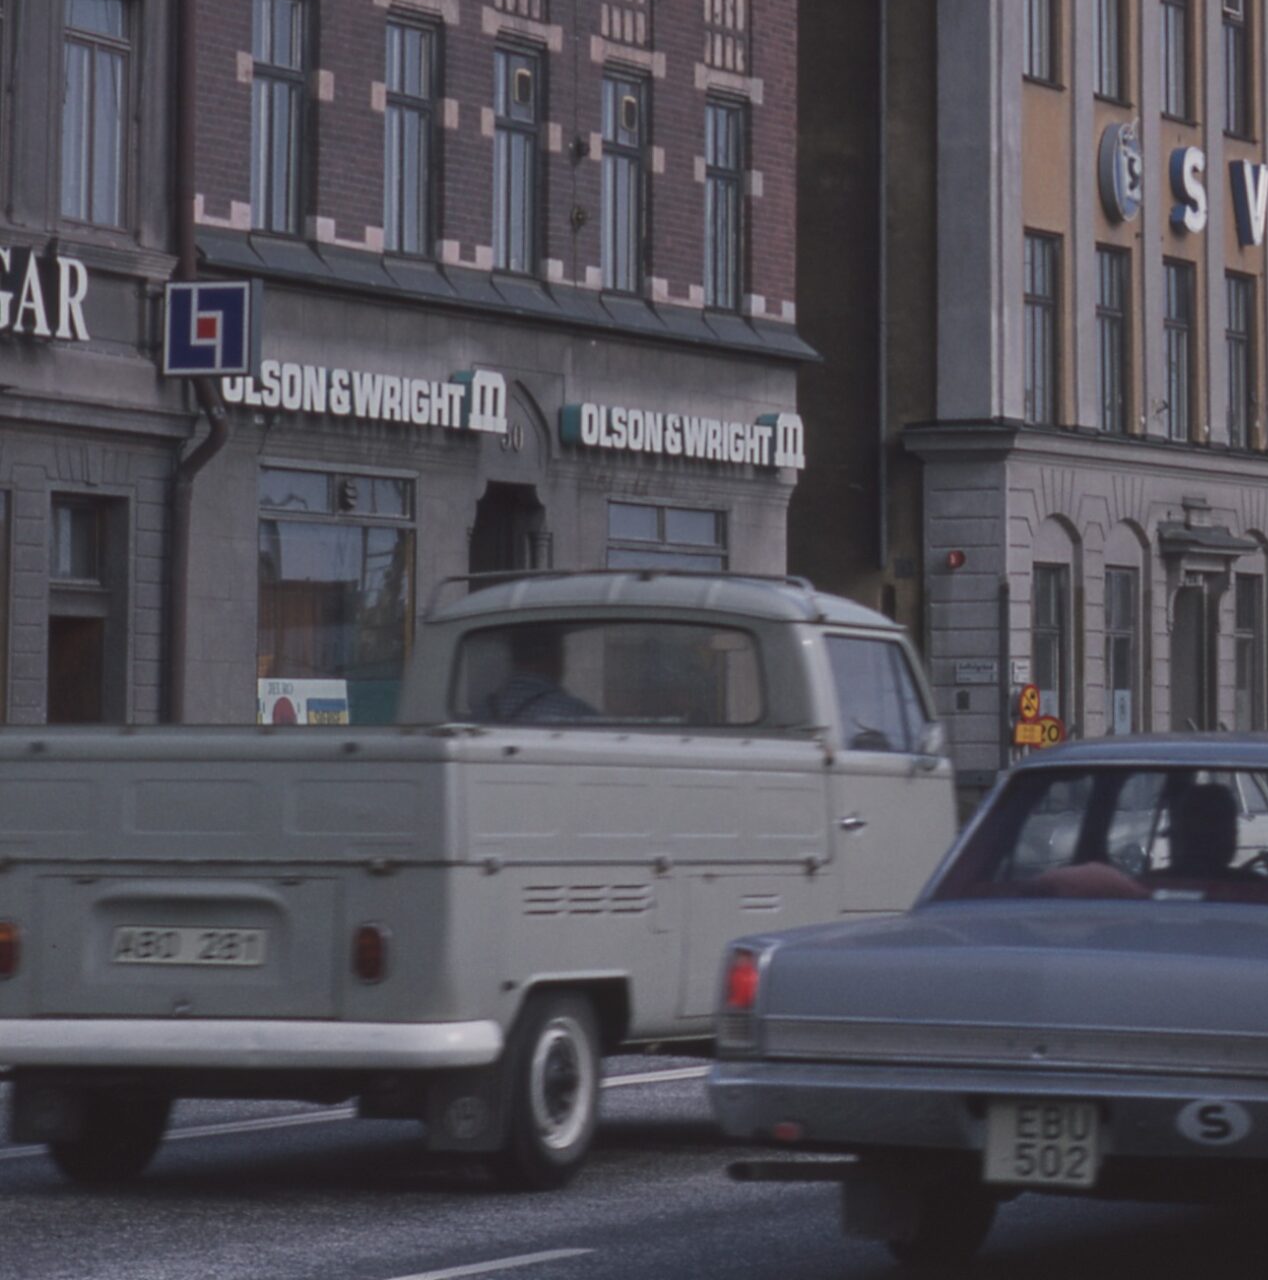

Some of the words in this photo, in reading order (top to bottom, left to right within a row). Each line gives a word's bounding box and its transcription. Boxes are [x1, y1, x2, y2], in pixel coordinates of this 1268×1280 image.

[1016, 1104, 1088, 1140] EBU
[1195, 1104, 1231, 1139] S
[1015, 1142, 1088, 1179] 502
